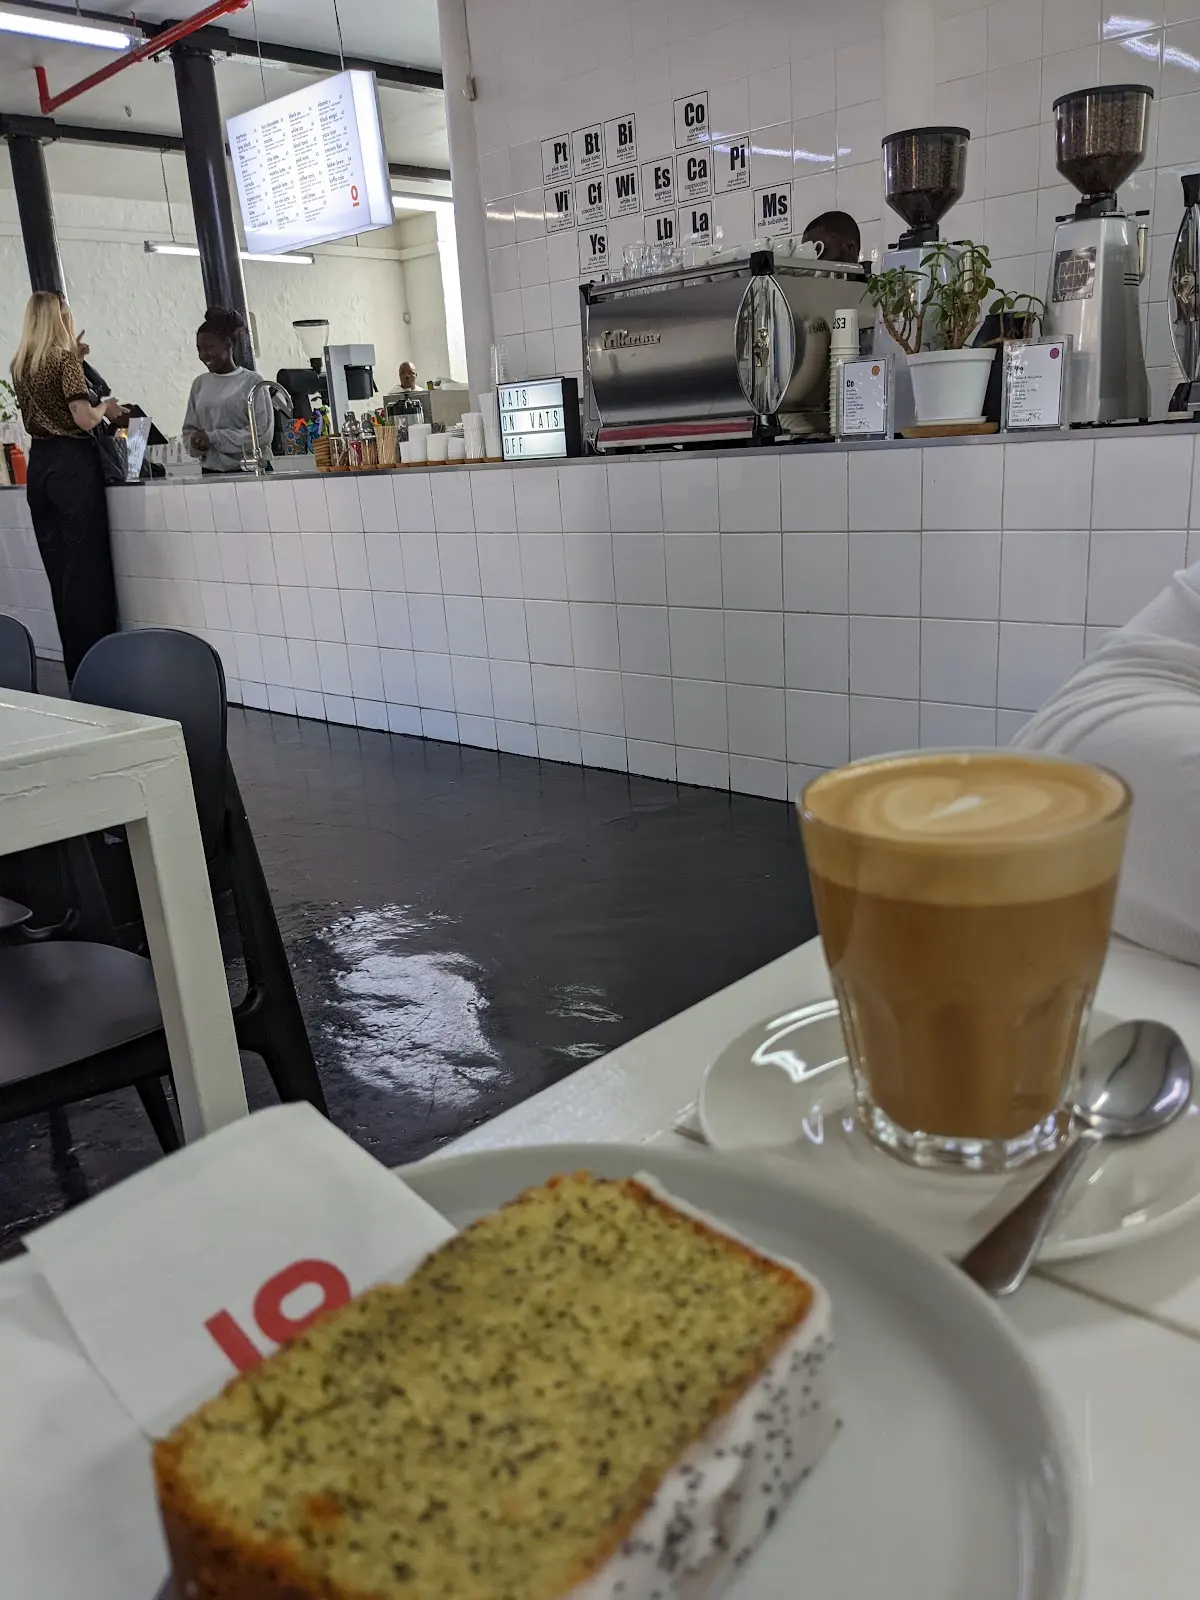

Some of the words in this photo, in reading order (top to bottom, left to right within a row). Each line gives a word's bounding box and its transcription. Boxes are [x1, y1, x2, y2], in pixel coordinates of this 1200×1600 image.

[684, 103, 705, 127] Co
[585, 133, 600, 155] Bt
[618, 121, 633, 146] Bi
[554, 142, 568, 164] Pt
[730, 144, 746, 171] Pi
[654, 167, 671, 190] Es
[687, 158, 707, 181] Ca
[588, 182, 602, 205] Cf
[616, 173, 635, 198] Wi
[762, 193, 788, 218] Ms
[657, 218, 673, 241] Lb
[692, 211, 709, 234] La
[590, 234, 605, 255] Ys
[501, 390, 527, 407] VATS
[503, 415, 514, 431] ON
[530, 410, 558, 428] VATS
[505, 437, 522, 454] OFF
